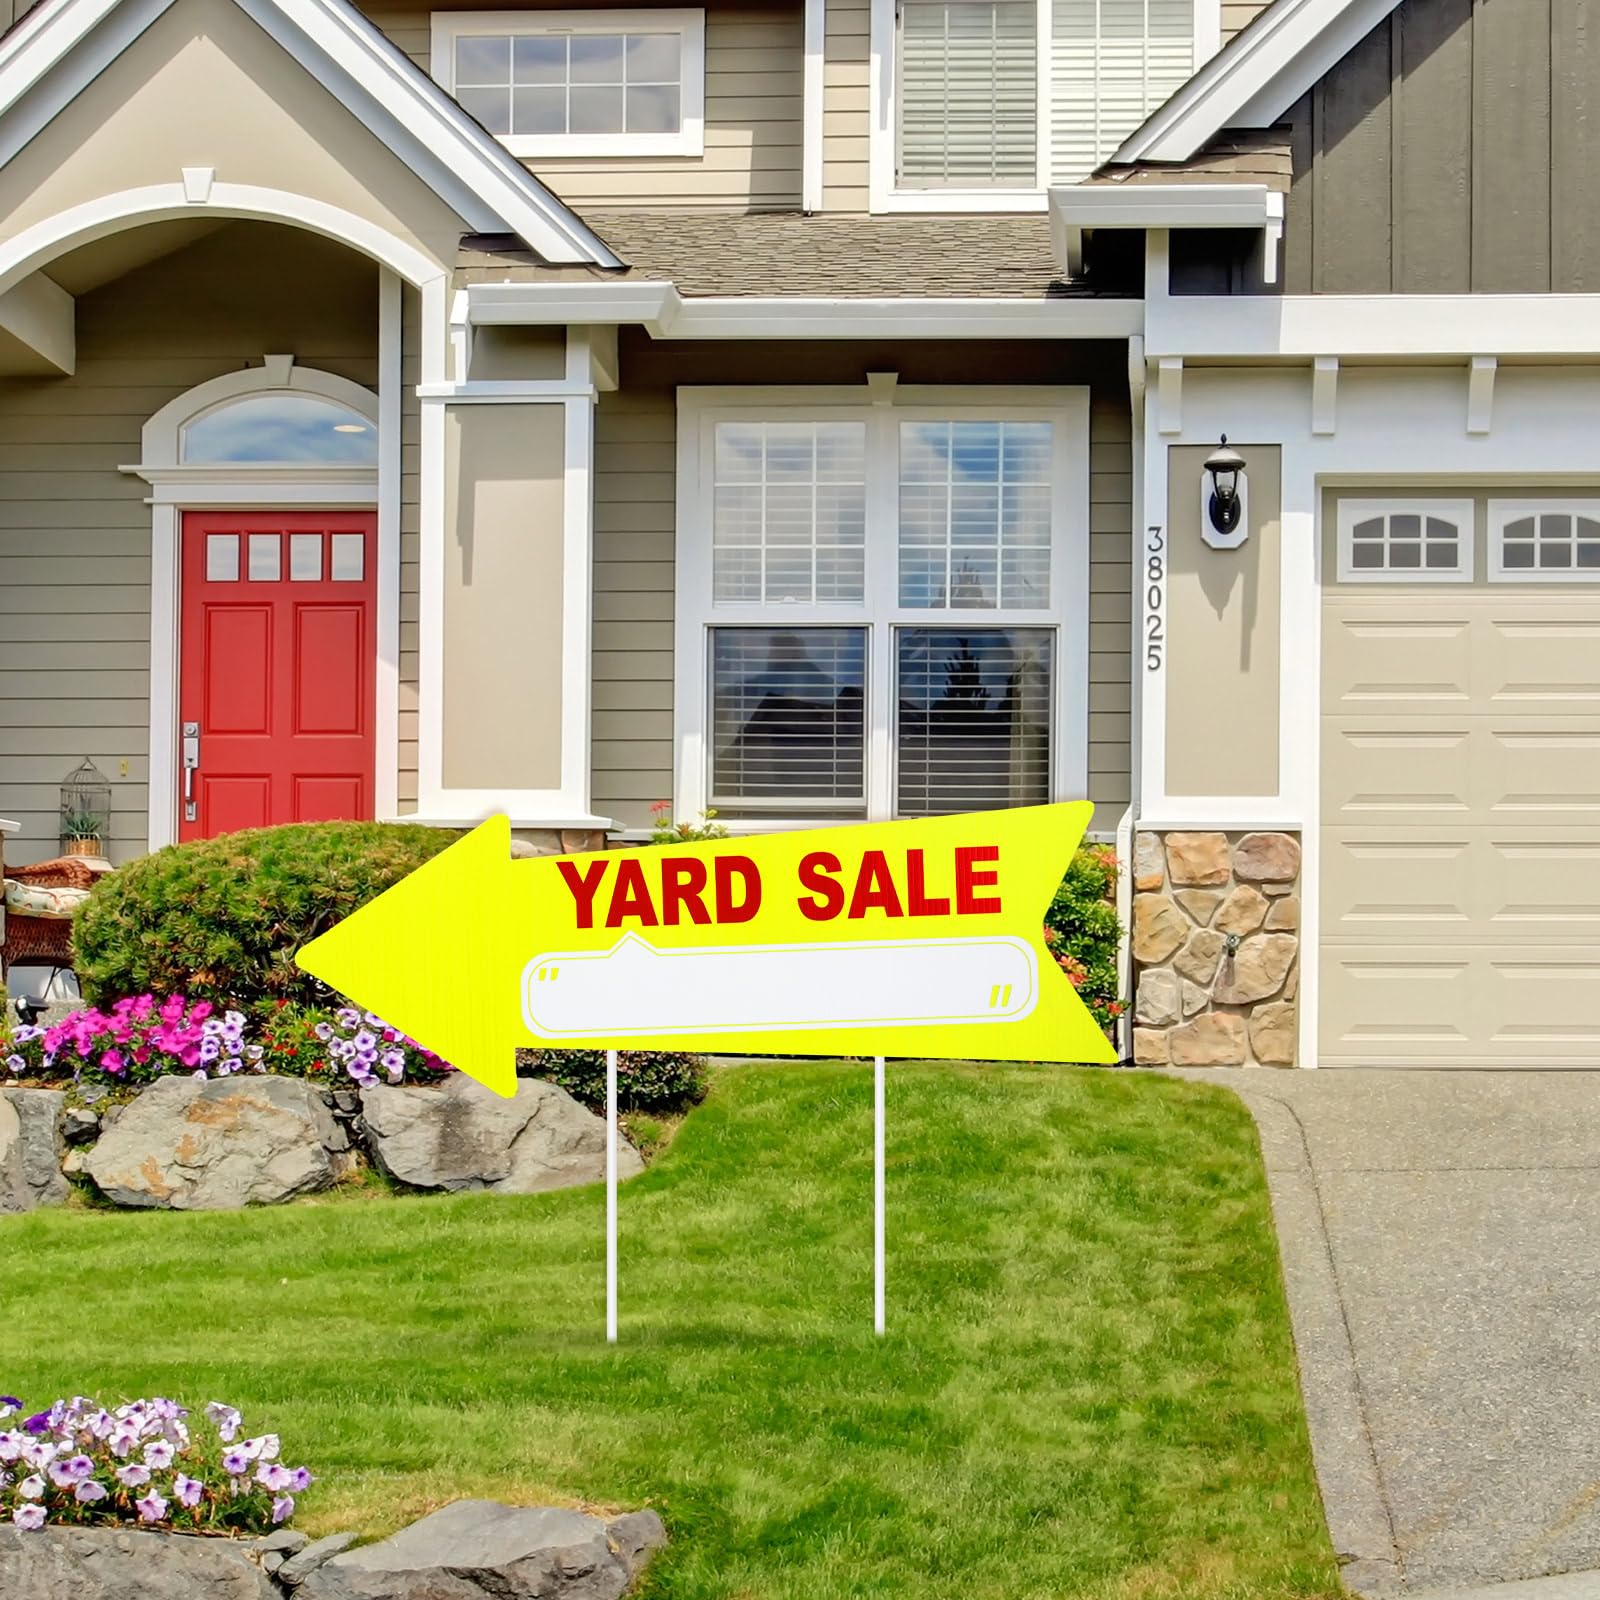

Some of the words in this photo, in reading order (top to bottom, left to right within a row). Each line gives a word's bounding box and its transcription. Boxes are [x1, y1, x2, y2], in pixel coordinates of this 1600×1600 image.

[1146, 526, 1164, 671] 38025
[557, 855, 762, 929] YARD
[798, 846, 1002, 921] SALE
